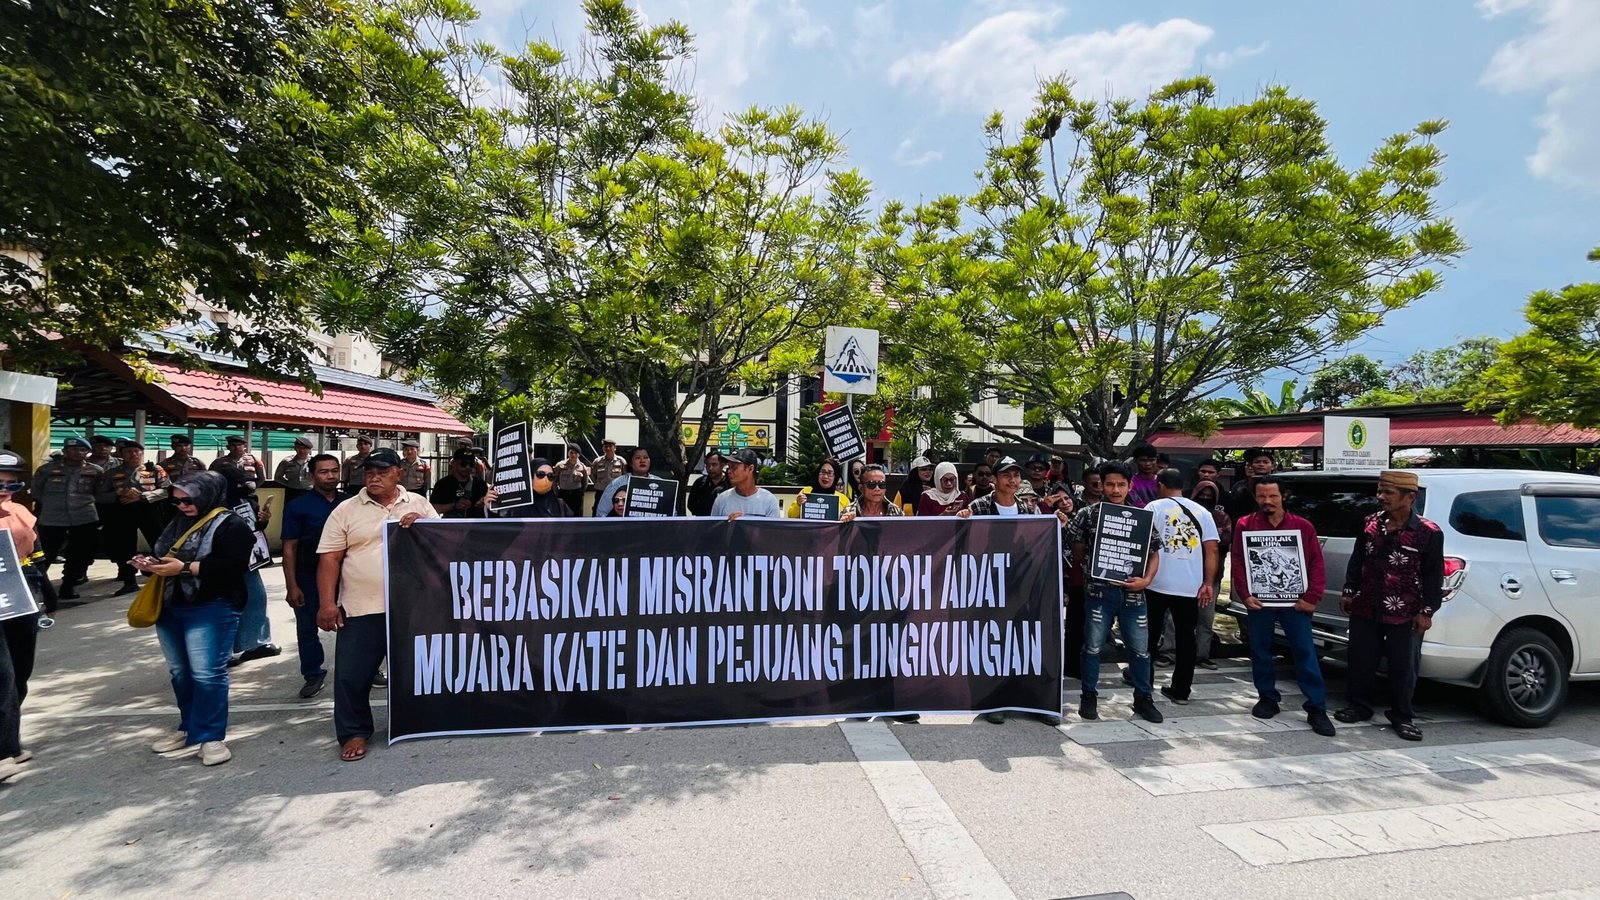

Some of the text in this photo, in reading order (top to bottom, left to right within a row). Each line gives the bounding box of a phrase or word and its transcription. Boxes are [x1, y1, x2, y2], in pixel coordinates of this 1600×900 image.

[450, 553, 1010, 621] BEBASKAN MISRANTONI TOKOH ADAT
[415, 620, 1041, 695] MUARA KATE DAN PEJUANG LINGKUNGAN
